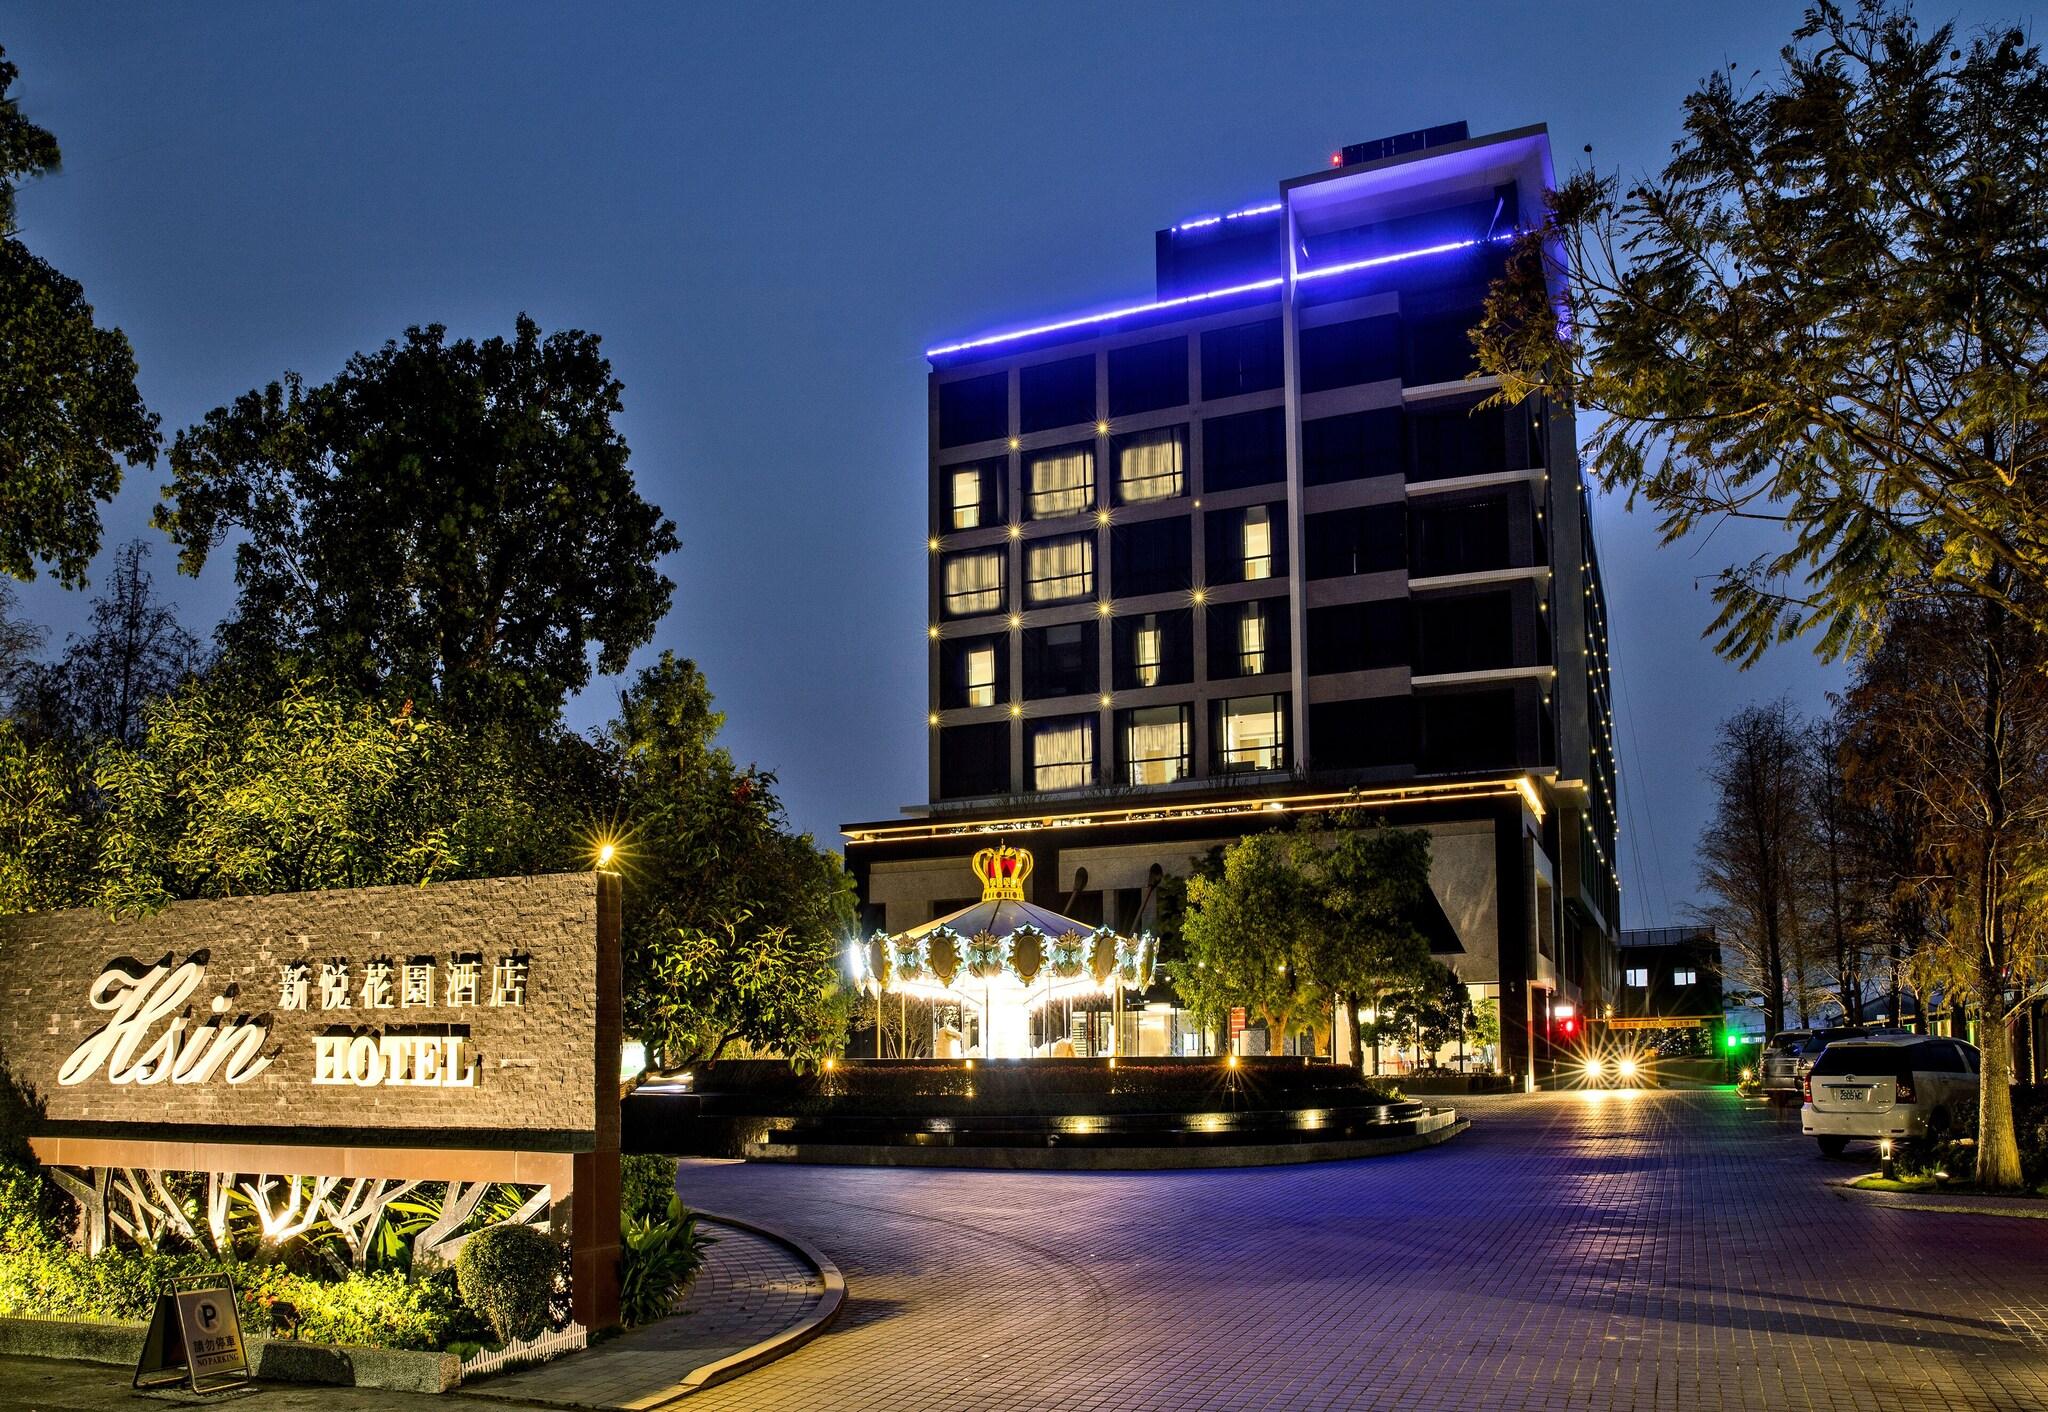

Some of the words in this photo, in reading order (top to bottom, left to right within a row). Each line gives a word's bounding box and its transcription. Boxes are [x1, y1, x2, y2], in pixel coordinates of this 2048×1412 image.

[58, 962, 276, 1085] Hsin
[312, 1035, 480, 1087] HOTEL
[202, 1304, 217, 1328] P
[192, 1335, 236, 1353] 請勿停車
[197, 1358, 208, 1367] NO
[208, 1353, 239, 1366] PARKING
